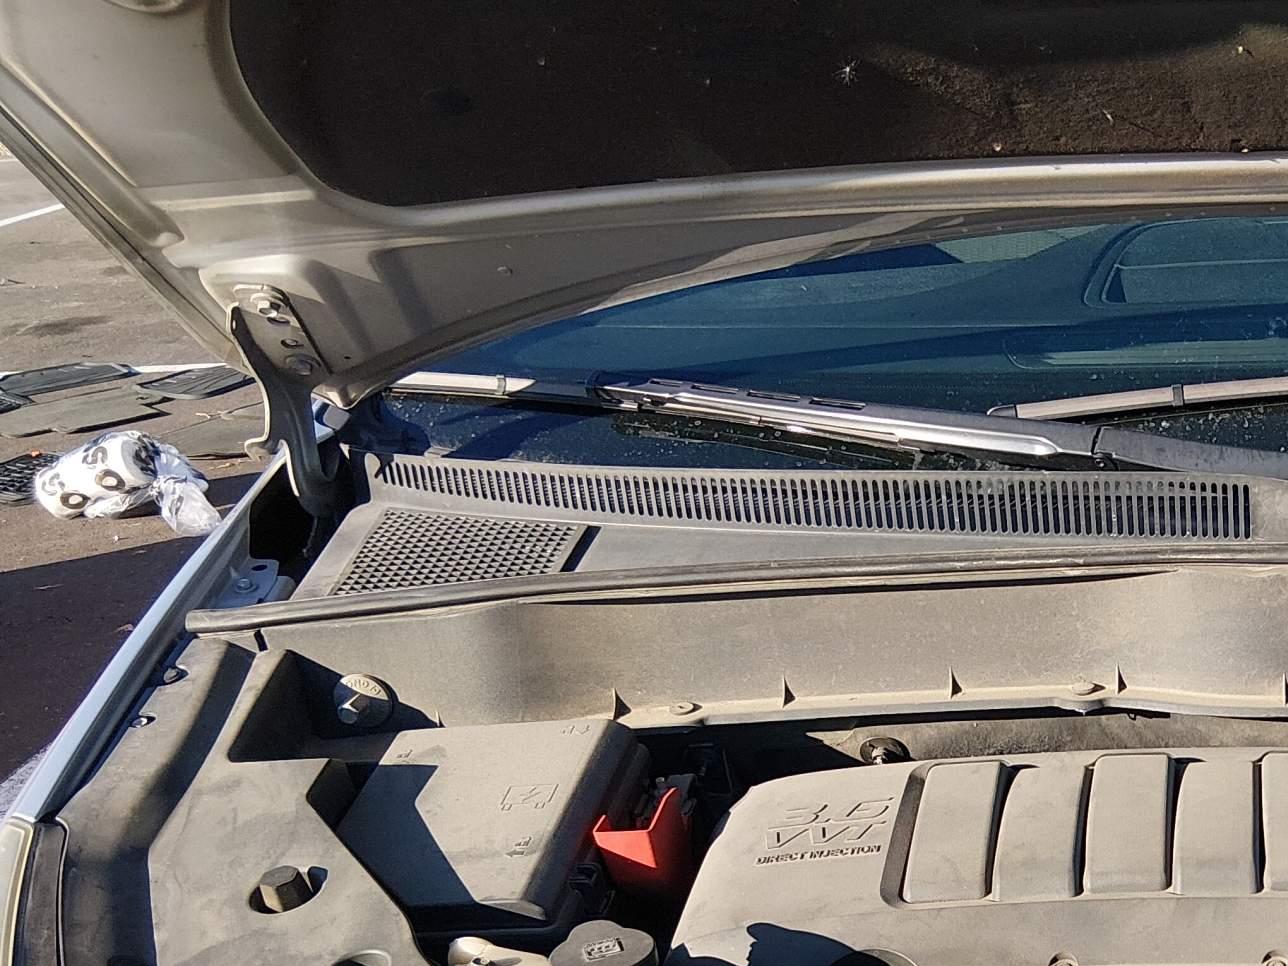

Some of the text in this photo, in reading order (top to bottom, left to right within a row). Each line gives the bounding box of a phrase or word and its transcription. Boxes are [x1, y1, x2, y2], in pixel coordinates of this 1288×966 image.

[768, 797, 894, 830] 3.6
[765, 821, 887, 850] VVT
[755, 845, 882, 865] DIRECT INJECTION
